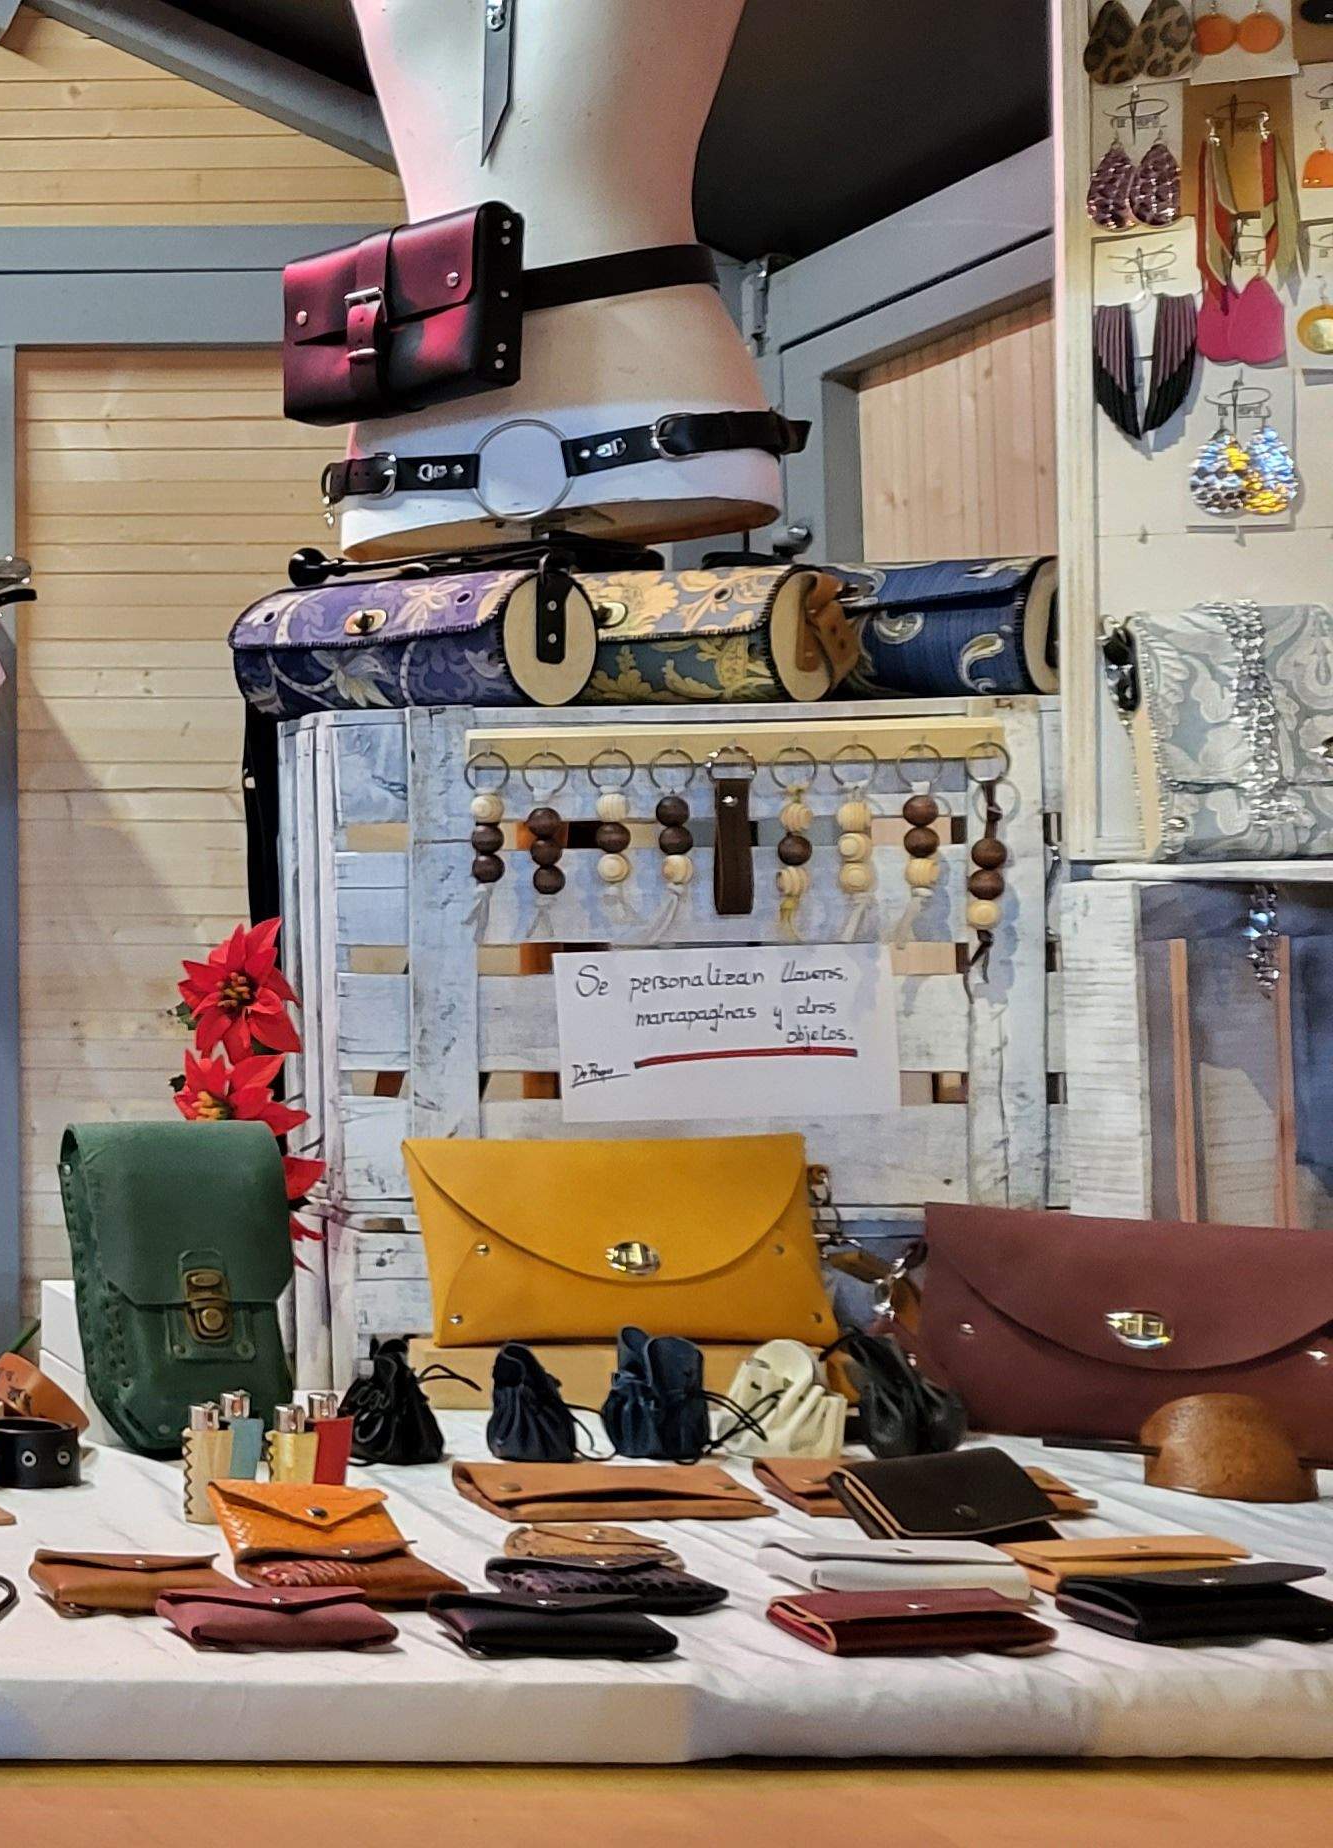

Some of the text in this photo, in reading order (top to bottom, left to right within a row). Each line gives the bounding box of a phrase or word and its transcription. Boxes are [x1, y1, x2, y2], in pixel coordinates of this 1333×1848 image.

[576, 964, 610, 998] Se
[629, 962, 765, 1002] personalizan
[773, 1009, 784, 1031] y
[786, 1025, 854, 1046] objetos.
